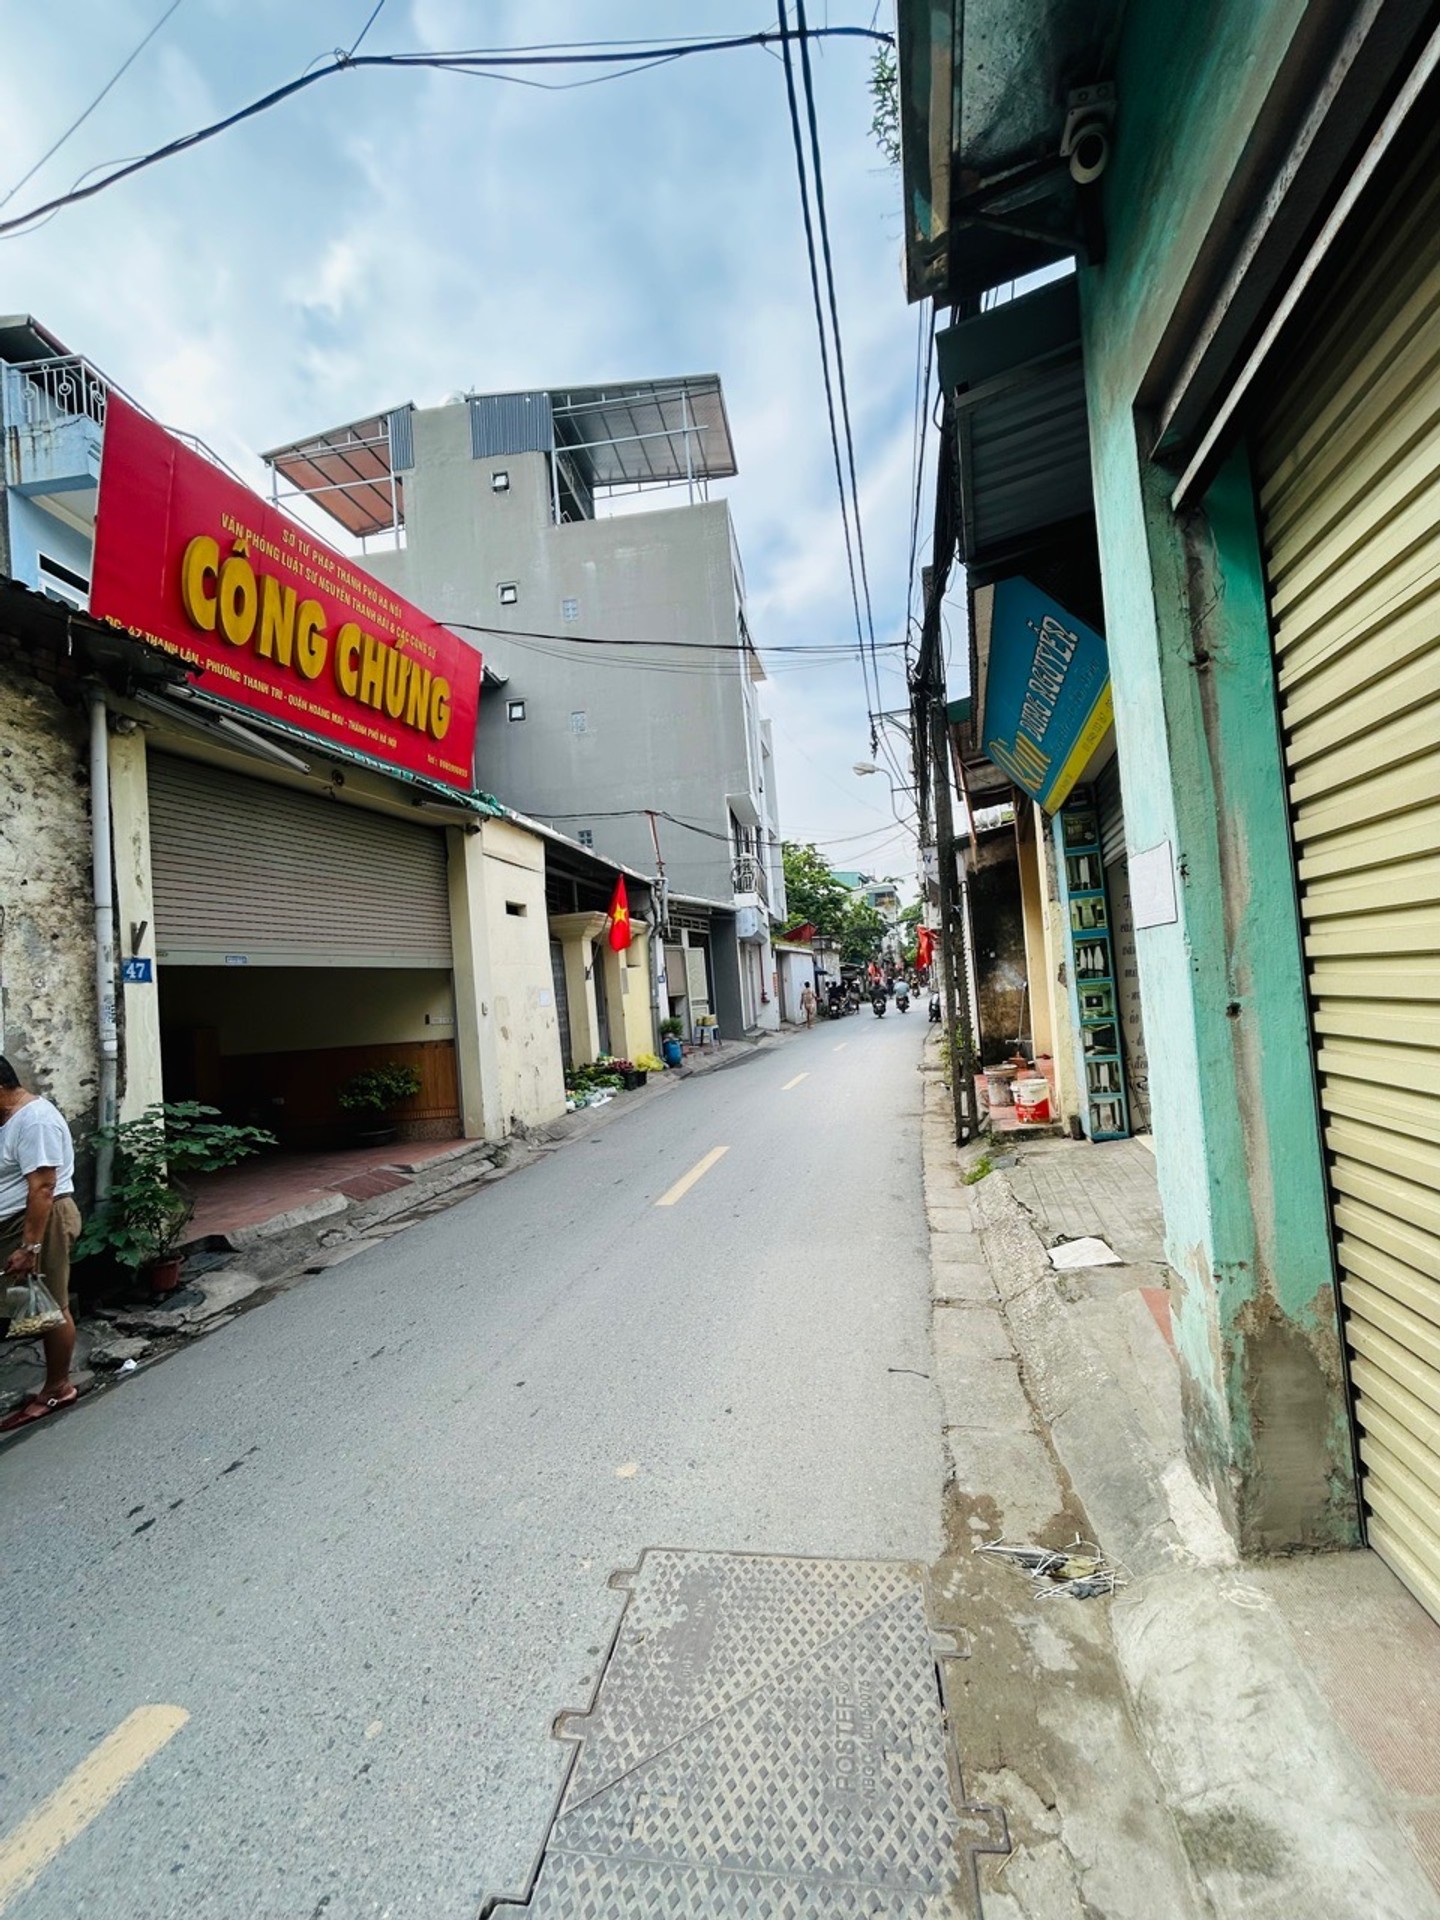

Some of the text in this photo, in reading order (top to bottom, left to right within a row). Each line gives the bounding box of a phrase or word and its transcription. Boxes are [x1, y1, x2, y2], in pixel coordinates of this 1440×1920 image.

[298, 540, 310, 557] TƯ
[182, 535, 450, 740] CÔNG CHỨNG
[206, 658, 241, 682] PHƯỜNG
[243, 674, 269, 694] THANH
[988, 730, 1052, 793] Rèm
[1026, 615, 1080, 707] NGUYỄN
[126, 962, 145, 979] 47
